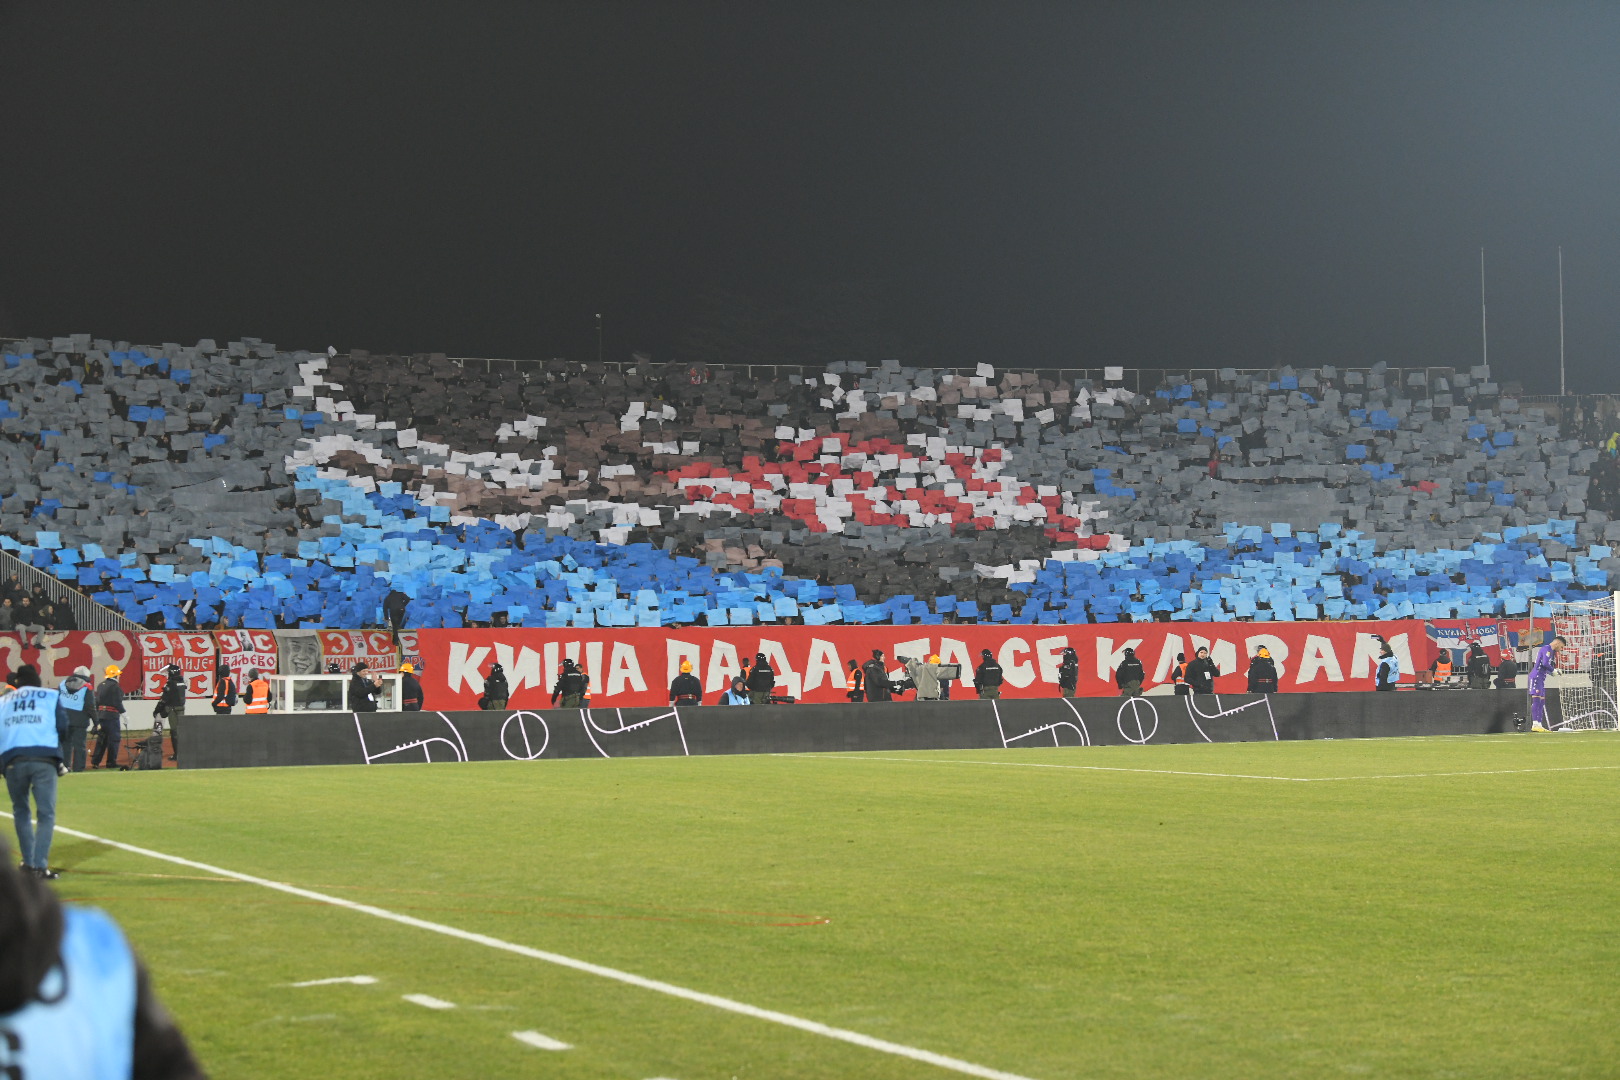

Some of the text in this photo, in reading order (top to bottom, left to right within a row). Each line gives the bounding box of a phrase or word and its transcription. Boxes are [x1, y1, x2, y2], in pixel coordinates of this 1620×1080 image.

[222, 654, 276, 668] ВАЉЕВО
[448, 641, 648, 699] КИША
[666, 638, 848, 700] ПАДА
[997, 634, 1069, 689] СЕ
[1096, 632, 1416, 685] КЛИЗАМ
[5, 690, 47, 702] PHOTO
[13, 699, 36, 712] 144
[12, 715, 42, 725] PARTIZAN
